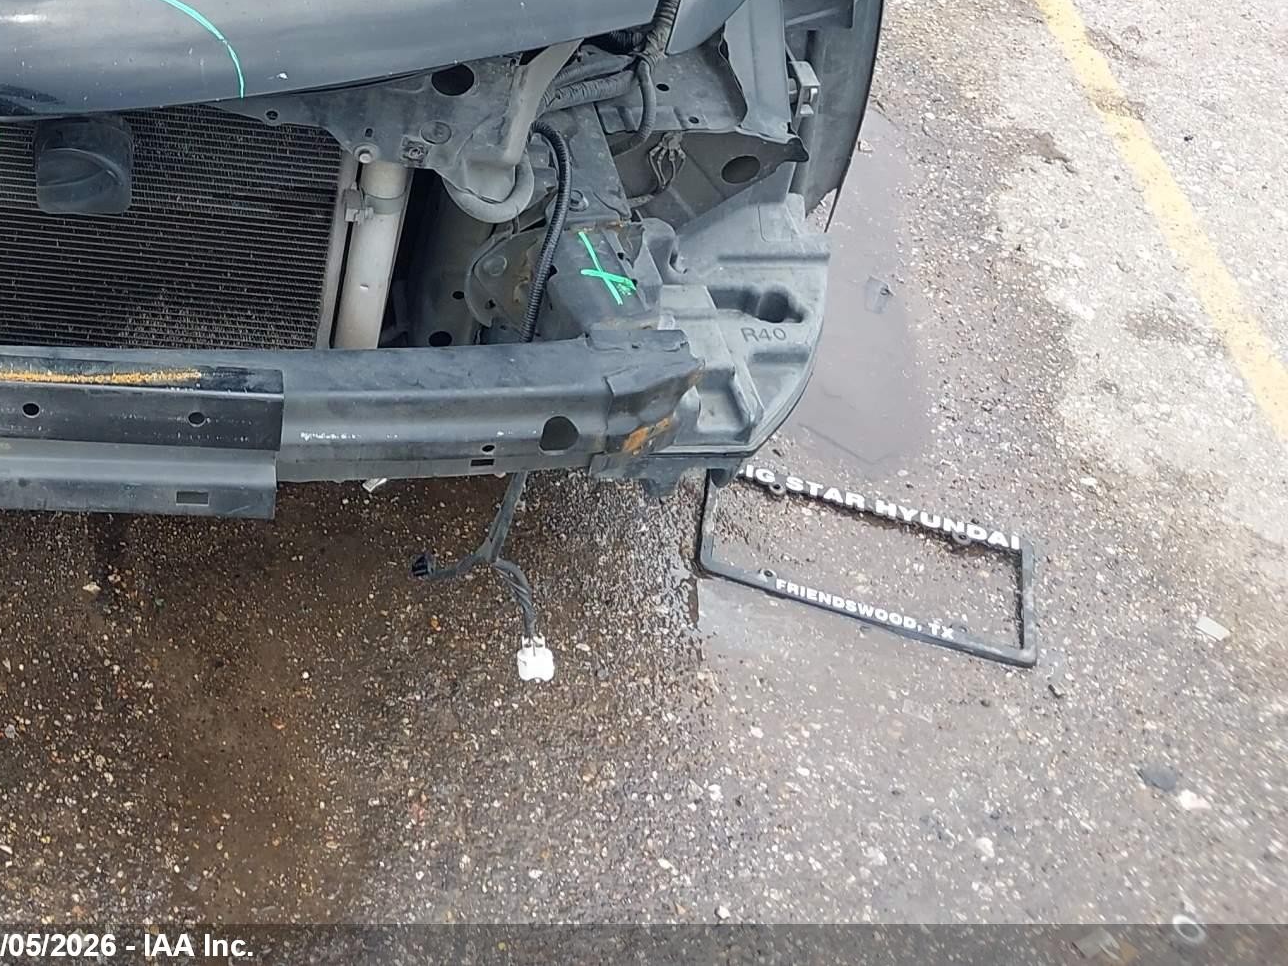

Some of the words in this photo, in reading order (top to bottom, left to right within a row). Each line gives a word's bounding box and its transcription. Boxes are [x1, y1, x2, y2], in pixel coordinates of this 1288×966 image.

[740, 327, 787, 343] R40
[738, 464, 776, 483] IG
[785, 476, 865, 512] STAR
[875, 499, 1020, 550] HYUNDAI
[776, 578, 922, 632] FRIENDSWOOD,
[928, 621, 955, 640] TX
